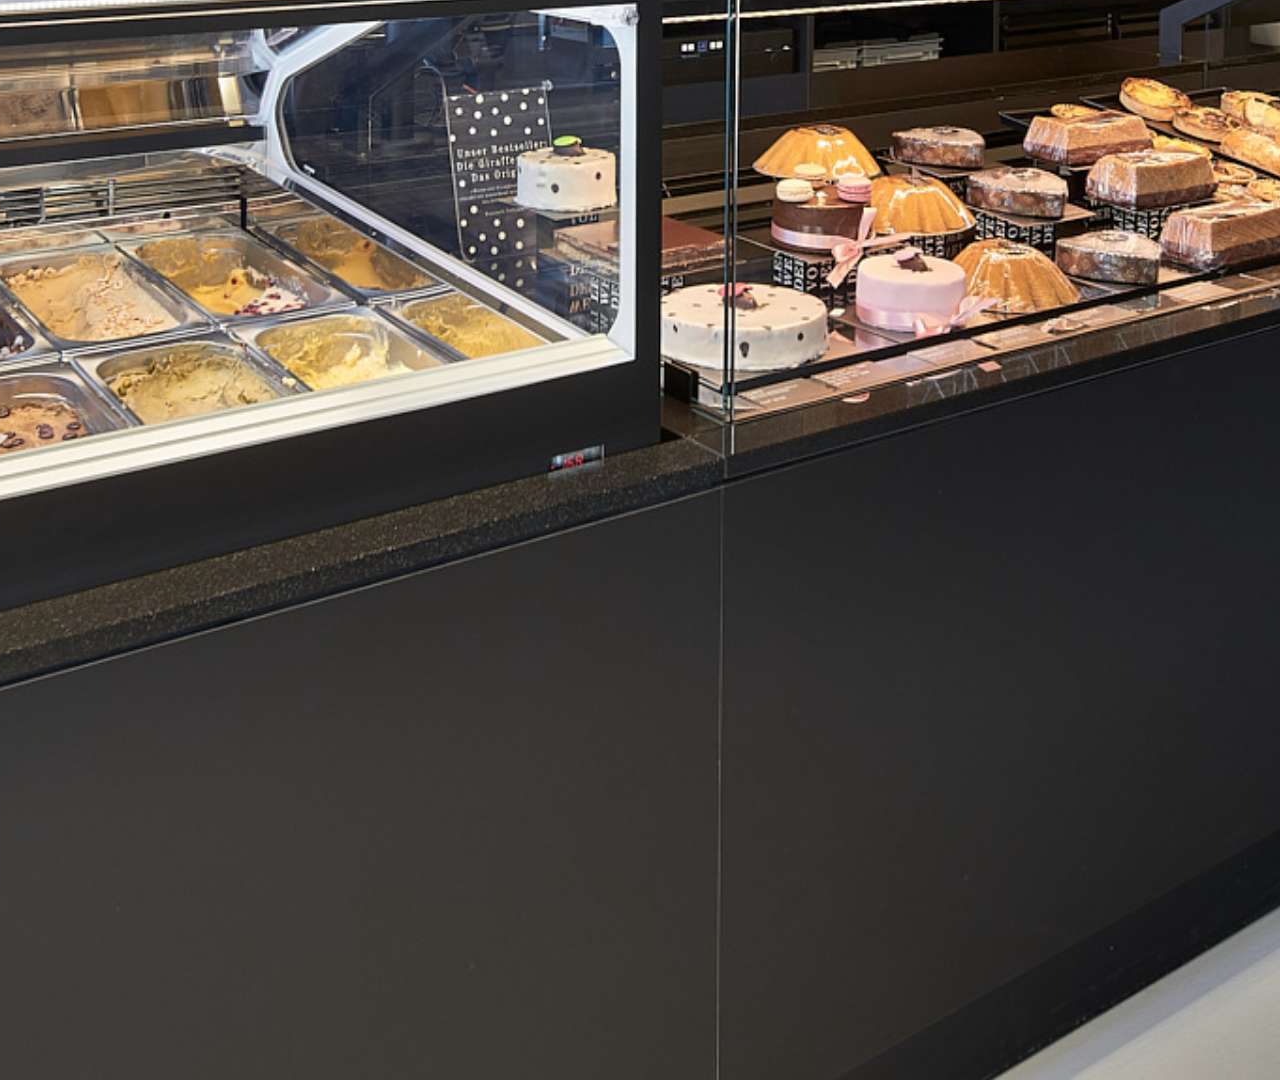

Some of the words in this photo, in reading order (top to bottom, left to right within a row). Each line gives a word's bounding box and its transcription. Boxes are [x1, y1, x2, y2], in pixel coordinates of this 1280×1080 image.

[456, 148, 487, 160] Unser
[456, 161, 474, 173] Die
[470, 172, 490, 183] Das
